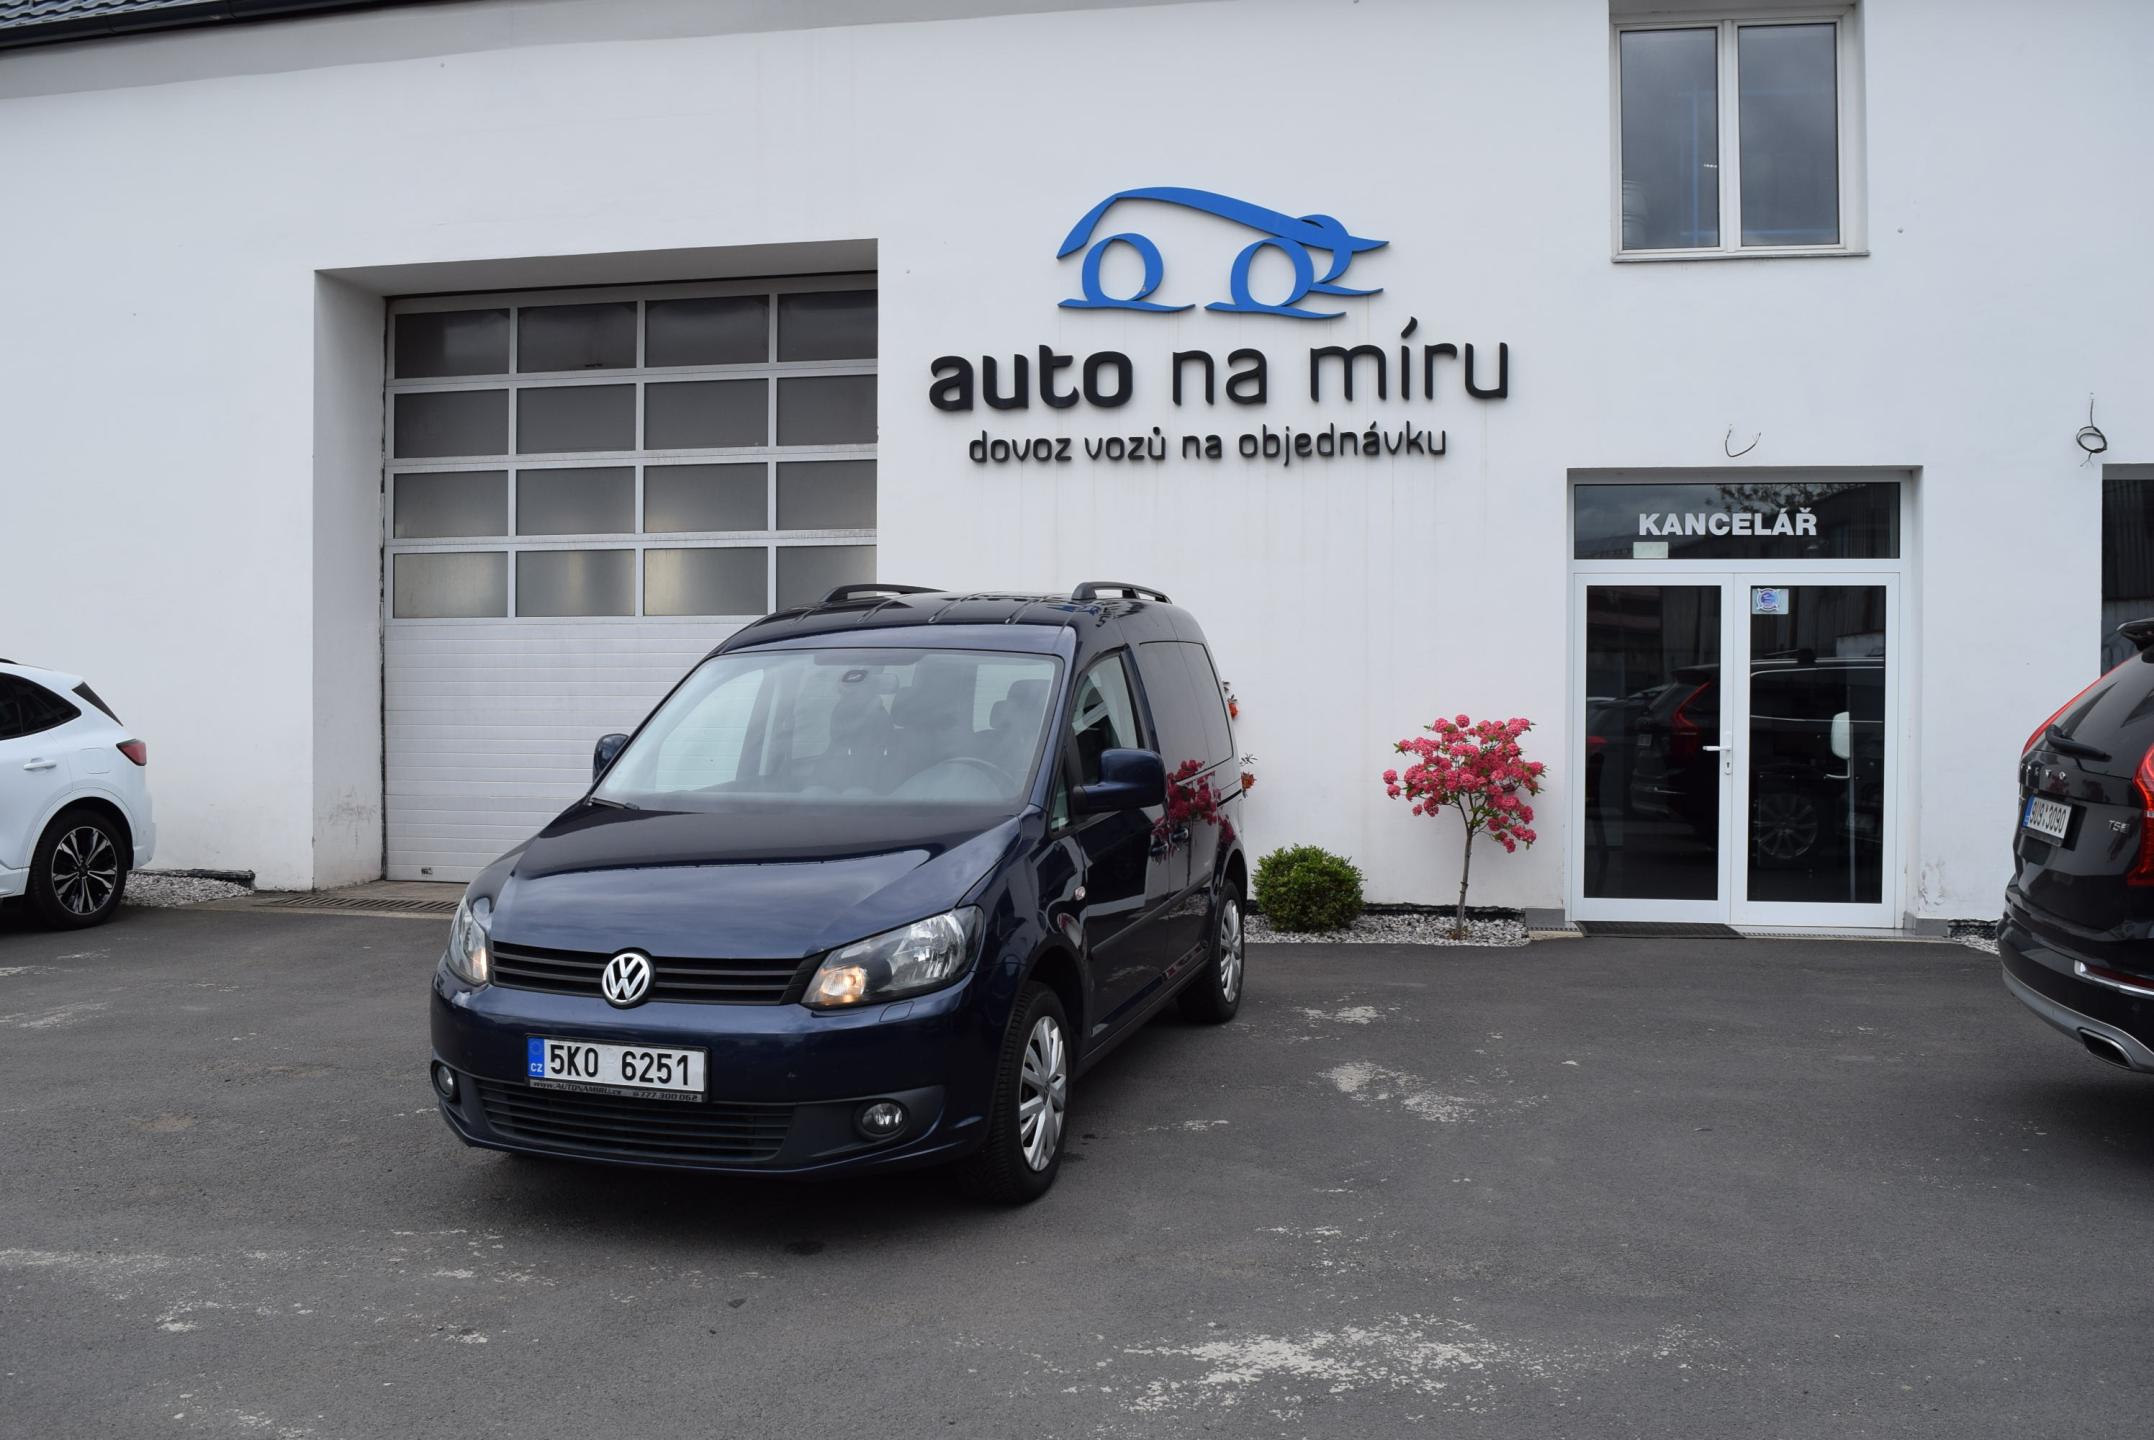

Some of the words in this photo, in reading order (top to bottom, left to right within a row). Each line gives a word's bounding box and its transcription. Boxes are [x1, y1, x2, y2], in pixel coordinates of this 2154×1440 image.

[929, 344, 1134, 410] auto
[1173, 348, 1268, 407] na
[1310, 316, 1509, 402] míru
[969, 430, 1073, 464] dovoz
[1084, 426, 1167, 463] vozů
[1182, 434, 1223, 462] na
[1238, 420, 1447, 468] objednávku
[1638, 507, 1818, 536] KANCELÁŘ
[530, 1062, 543, 1073] CZ
[550, 1044, 599, 1078] 5K0
[621, 1051, 690, 1086] 6251
